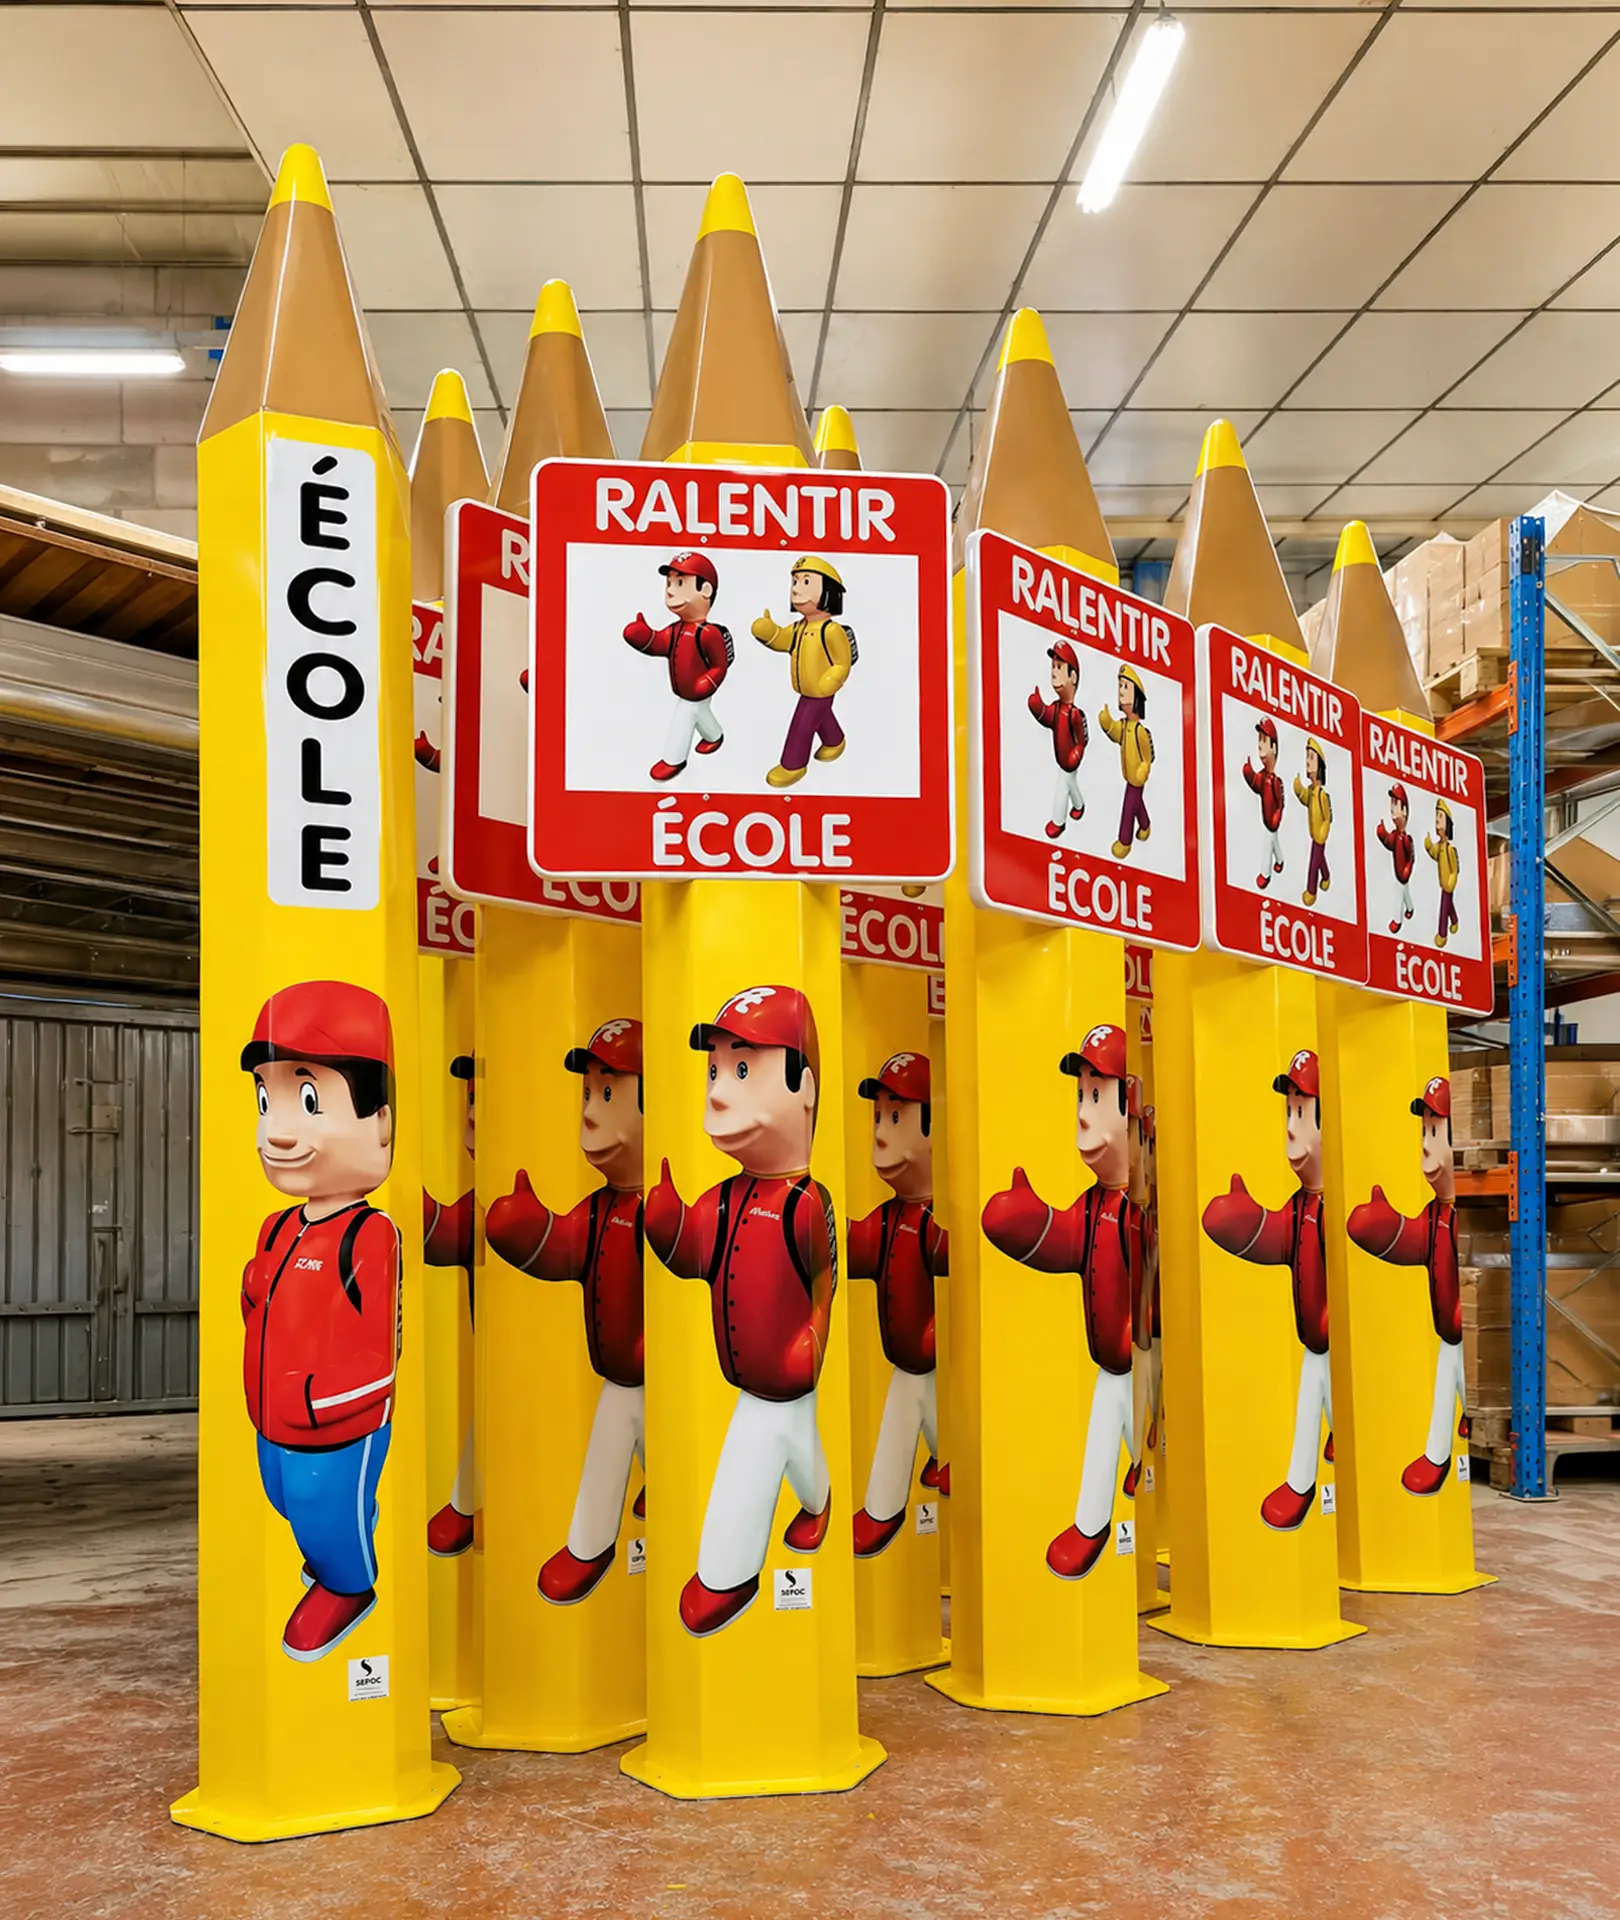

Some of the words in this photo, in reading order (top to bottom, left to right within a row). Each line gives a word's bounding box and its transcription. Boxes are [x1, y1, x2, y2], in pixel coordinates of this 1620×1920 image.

[595, 477, 897, 543] RALENTIR
[1011, 555, 1172, 667] RALENTIR
[286, 455, 365, 892] ÉCOLE
[1230, 645, 1344, 738] RALENTIR
[1368, 722, 1469, 798] RALENTIR
[652, 796, 853, 868] ÉCOLE
[1047, 849, 1153, 931] ÉCOLE
[1260, 899, 1336, 971] ÉCOLE
[1395, 942, 1463, 1001] ÉCOLE
